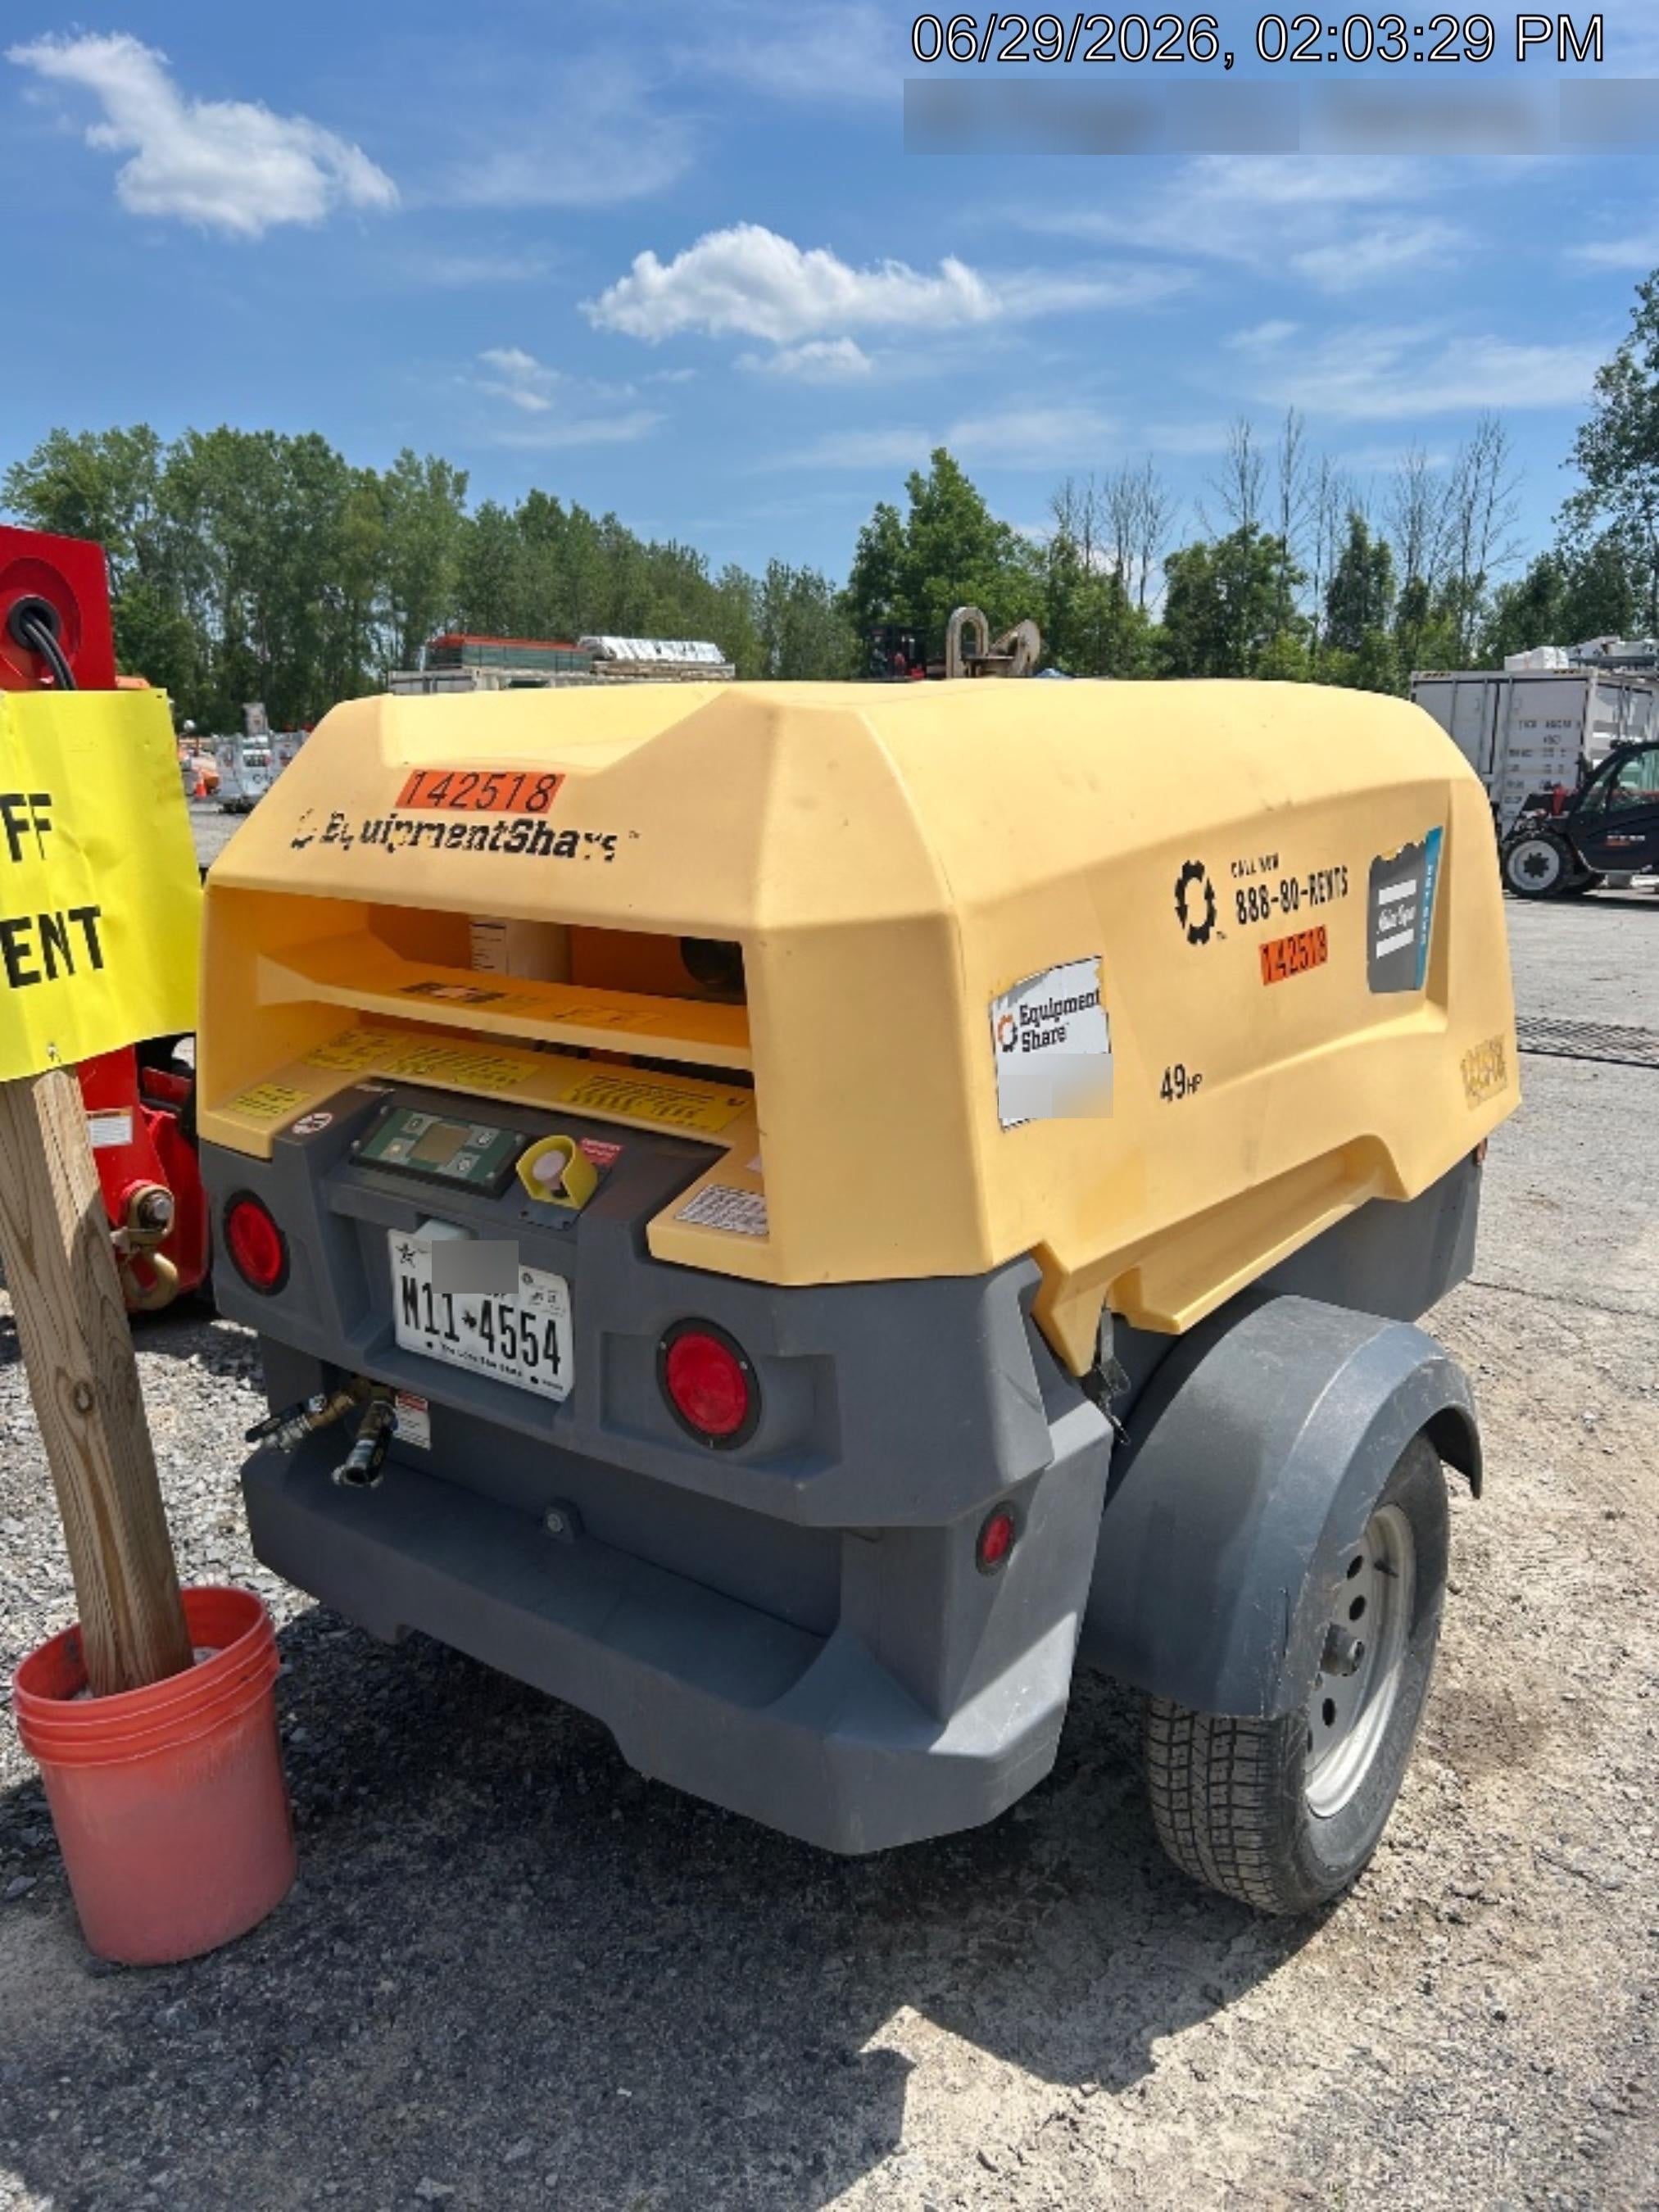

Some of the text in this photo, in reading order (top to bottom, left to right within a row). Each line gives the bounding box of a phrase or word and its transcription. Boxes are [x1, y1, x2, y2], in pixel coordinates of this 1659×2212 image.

[407, 772, 557, 812] 142518
[1019, 988, 1100, 1027] Equipment
[1022, 1025, 1065, 1053] Share
